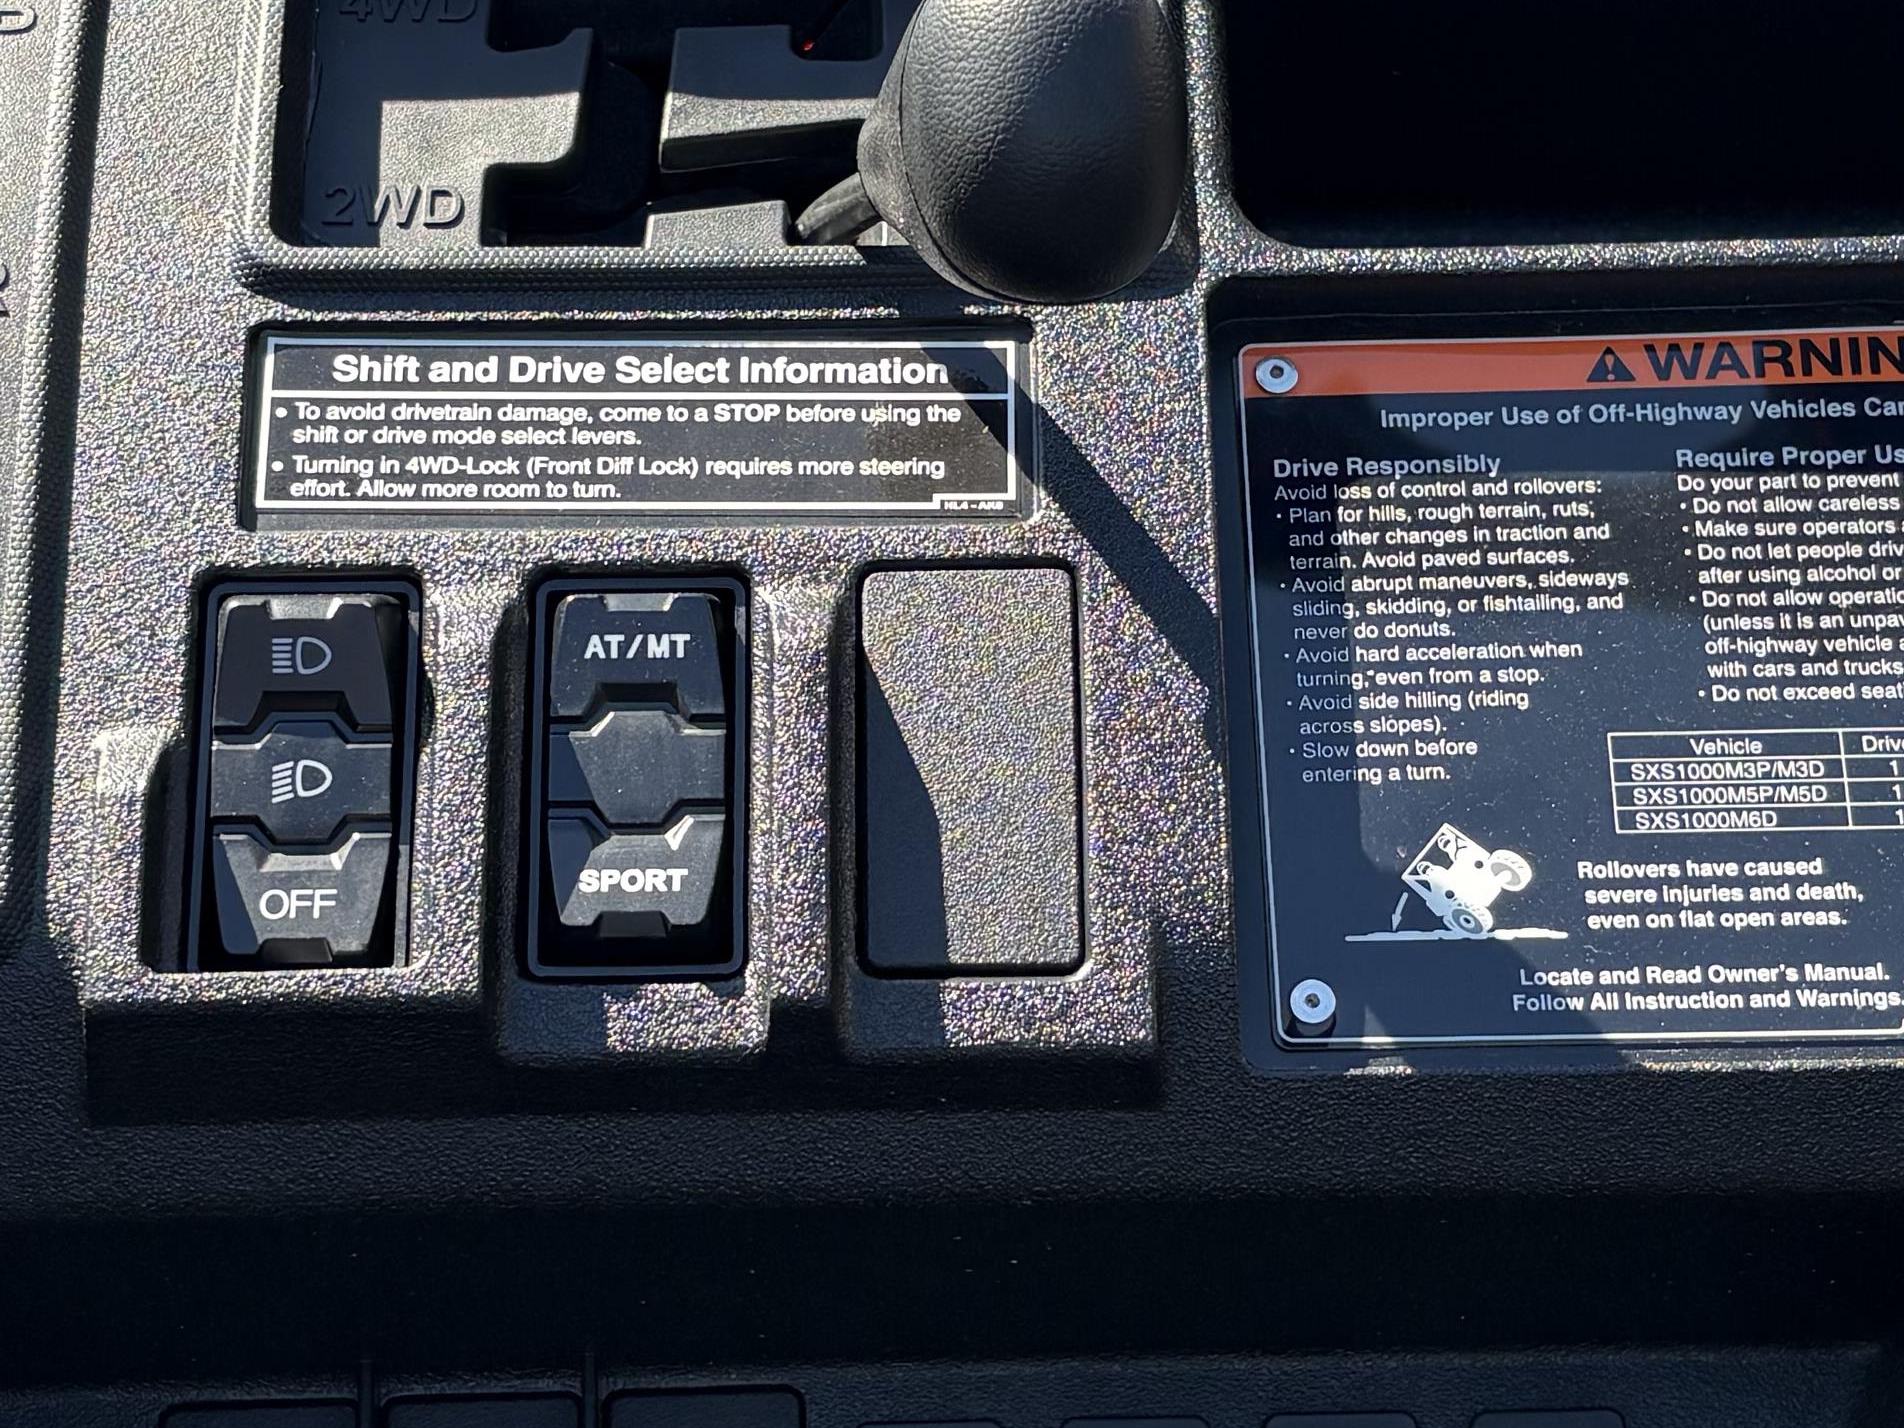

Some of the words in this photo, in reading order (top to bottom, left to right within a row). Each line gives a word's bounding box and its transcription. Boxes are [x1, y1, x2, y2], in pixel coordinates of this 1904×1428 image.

[322, 183, 465, 230] 2WD
[331, 354, 420, 382] Shift
[428, 355, 498, 383] and
[509, 355, 605, 383] Drive
[616, 353, 730, 383] Select
[740, 356, 948, 384] Information
[294, 402, 320, 420] To
[326, 402, 385, 420] avoid
[391, 402, 492, 421] drivetrain
[497, 403, 593, 426] damage,
[599, 407, 662, 422] come
[666, 405, 689, 422] to
[694, 407, 709, 422] a
[714, 403, 780, 422] STOP
[786, 404, 856, 422] before
[861, 402, 920, 426] using
[926, 404, 961, 422] the
[1381, 410, 1493, 432] Improper
[1502, 407, 1549, 425] Use
[1557, 405, 1580, 424] of
[1589, 403, 1742, 425] Off-Highway
[1751, 399, 1856, 418] Vehicles
[290, 425, 339, 443] shift
[344, 429, 368, 444] or
[372, 426, 427, 444] drive
[432, 426, 496, 444] mode
[501, 426, 566, 445] select
[570, 426, 641, 445] levers.
[292, 455, 374, 478] Turning
[380, 455, 400, 474] in
[405, 456, 520, 475] 4WD-Lock
[526, 456, 591, 479] (Front
[597, 457, 634, 475] Diff
[639, 457, 698, 479] Lock)
[706, 457, 793, 479] requires
[798, 461, 854, 475] more
[859, 457, 945, 479] steering
[1274, 459, 1338, 477] Drive
[1347, 454, 1500, 480] Responsibly
[1676, 448, 1774, 471] Require
[1782, 447, 1866, 469] Proper
[289, 479, 351, 497] effort.
[355, 479, 416, 497] Allow
[421, 483, 478, 498] more
[483, 483, 540, 498] room
[545, 481, 567, 498] to
[572, 481, 621, 498] turn.
[1699, 567, 1742, 584] after
[1748, 566, 1801, 587] using
[1807, 564, 1876, 582] alcohol
[1882, 567, 1902, 580] or
[1295, 627, 1348, 639] never
[1354, 622, 1378, 639] do
[1384, 621, 1455, 638] donuts.
[583, 633, 691, 659] AT/MT
[1690, 738, 1763, 755] Vehicle
[1630, 760, 1825, 781] SXS1000M3P/M3D
[1890, 760, 1899, 776] 1
[1633, 785, 1828, 806] SXS1000M5P/M5D
[1893, 784, 1902, 800] 1
[1635, 810, 1778, 830] SXS1000M6D
[1896, 808, 1904, 825] 1
[1578, 861, 1681, 879] Rollovers
[1686, 860, 1739, 877] have
[1744, 857, 1823, 876] caused
[578, 868, 689, 893] SPORT
[259, 889, 338, 920] OFF
[1585, 889, 1658, 904] severe
[1663, 884, 1744, 907] injuries
[1750, 883, 1790, 902] and
[1796, 882, 1864, 902] death,
[1588, 915, 1640, 929] even
[1646, 914, 1674, 928] on
[1679, 910, 1715, 928] flat
[1720, 912, 1775, 931] open
[1781, 911, 1847, 926] areas.
[1520, 968, 1594, 986] Locate
[1599, 967, 1640, 985] and
[1646, 965, 1702, 984] Read
[1708, 964, 1799, 983] Owner's
[1804, 962, 1890, 981] Manual.
[1513, 994, 1584, 1011] Follow
[1590, 992, 1619, 1011] All
[1625, 991, 1744, 1010] Instruction
[1750, 990, 1791, 1008] and
